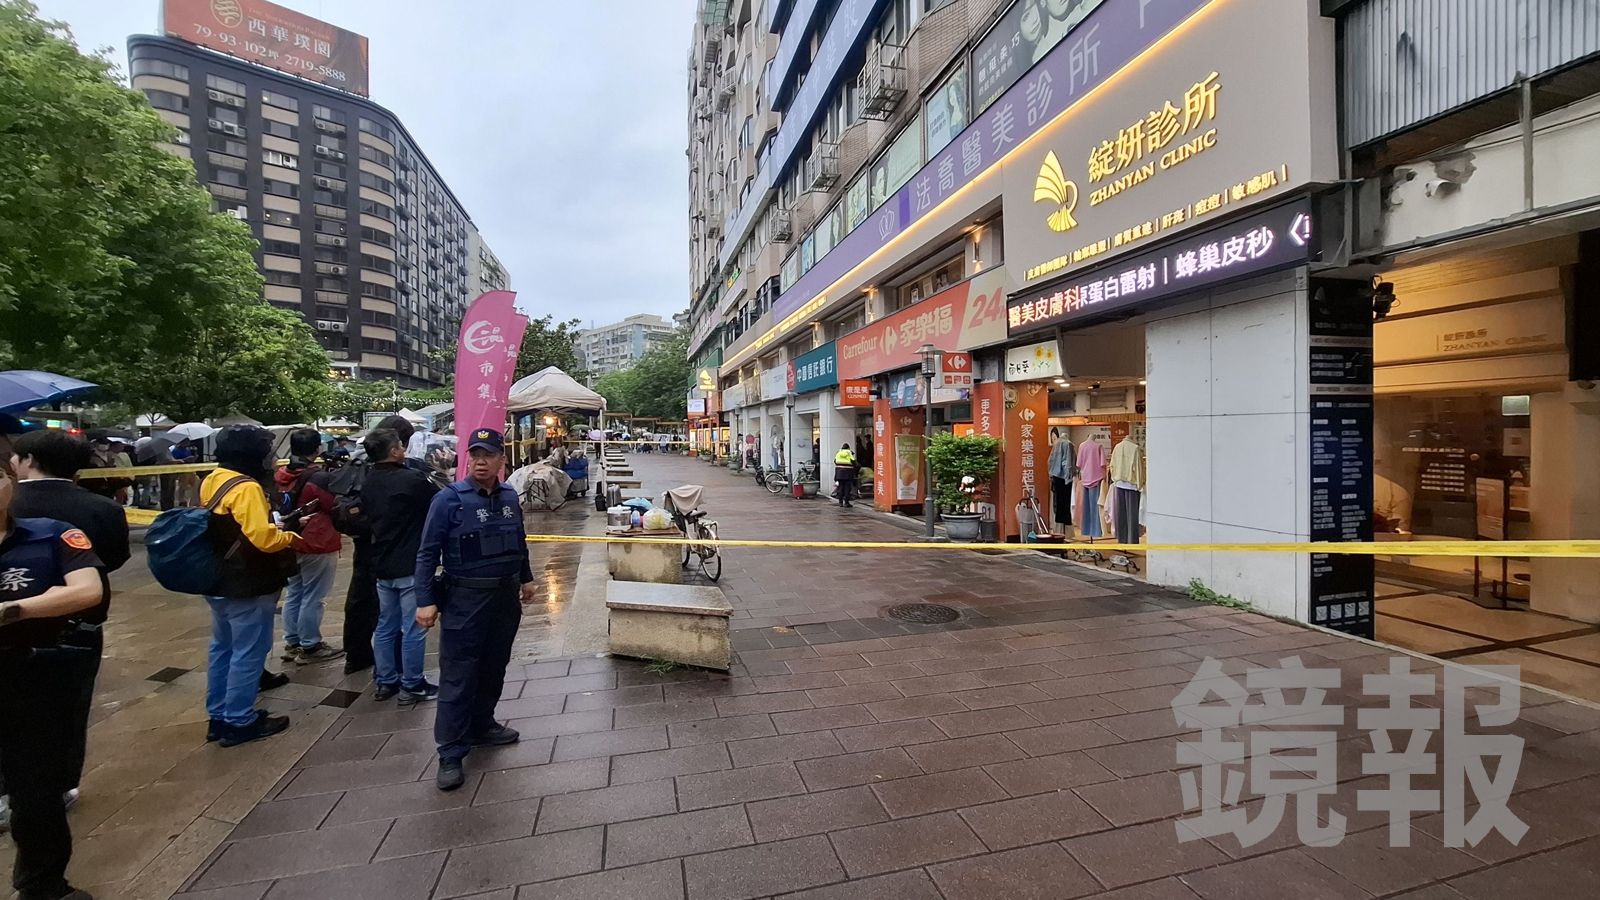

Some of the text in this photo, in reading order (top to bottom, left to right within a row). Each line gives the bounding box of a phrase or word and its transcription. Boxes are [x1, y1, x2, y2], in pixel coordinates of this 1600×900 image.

[285, 54, 346, 83] 2719-5888
[916, 23, 1101, 213] 法喬醫美診所
[1088, 71, 1222, 183] 綻妍診所
[1089, 128, 1217, 207] ZHANYAN CLINIC
[1232, 174, 1277, 201] 敏感肌
[1176, 226, 1274, 280] 蜂巢皮秒
[843, 335, 878, 360] Carrefour
[900, 303, 953, 347] 家樂福
[477, 360, 494, 399] 市集
[797, 356, 833, 382] 中國信託銀行
[1021, 423, 1035, 498] 家樂福超市
[476, 507, 514, 523] 警察
[0, 567, 35, 592] 察
